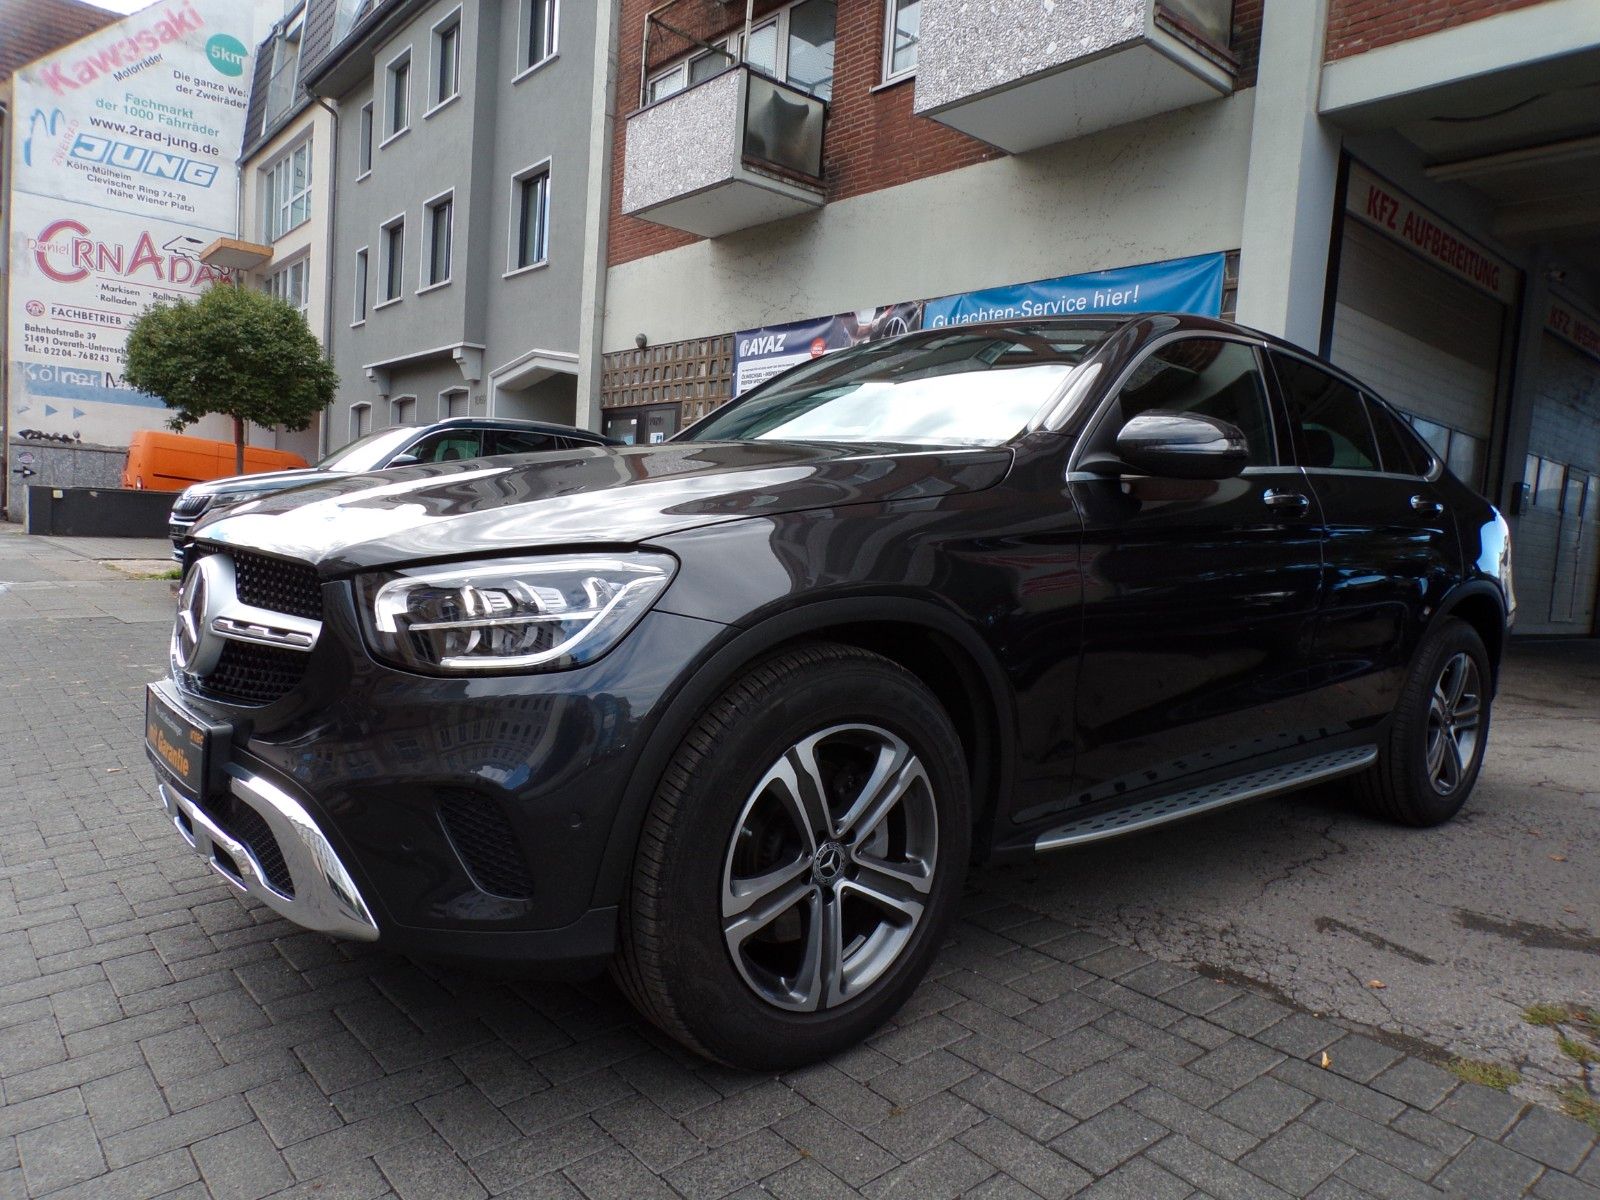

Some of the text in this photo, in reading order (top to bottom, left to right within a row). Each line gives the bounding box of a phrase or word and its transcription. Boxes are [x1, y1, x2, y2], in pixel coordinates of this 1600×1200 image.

[39, 0, 206, 96] Kawasaki
[113, 52, 164, 82] Motorräder
[173, 69, 191, 84] Die
[193, 77, 225, 94] ganze
[125, 93, 194, 119] Fachmarkt
[175, 84, 248, 110] der Zweiräder
[95, 98, 220, 138] der 1000 Fahrräder
[89, 116, 220, 157] www.2rad-jung.de
[66, 160, 132, 182] Köln-Mülheim
[69, 133, 219, 189] JUNG
[87, 174, 187, 203] Clevischer Ring 74-78
[106, 188, 196, 214] (Nähe Wiener Platz)
[1367, 185, 1500, 292] KFZ AUFBEREITUNG
[100, 294, 138, 308] Rolladen
[101, 282, 141, 298] Markisen
[51, 306, 122, 326] FACHBETRIEB
[932, 284, 1140, 327] Gutachten-Service hier!
[24, 334, 50, 345] 51491
[87, 332, 97, 341] 39
